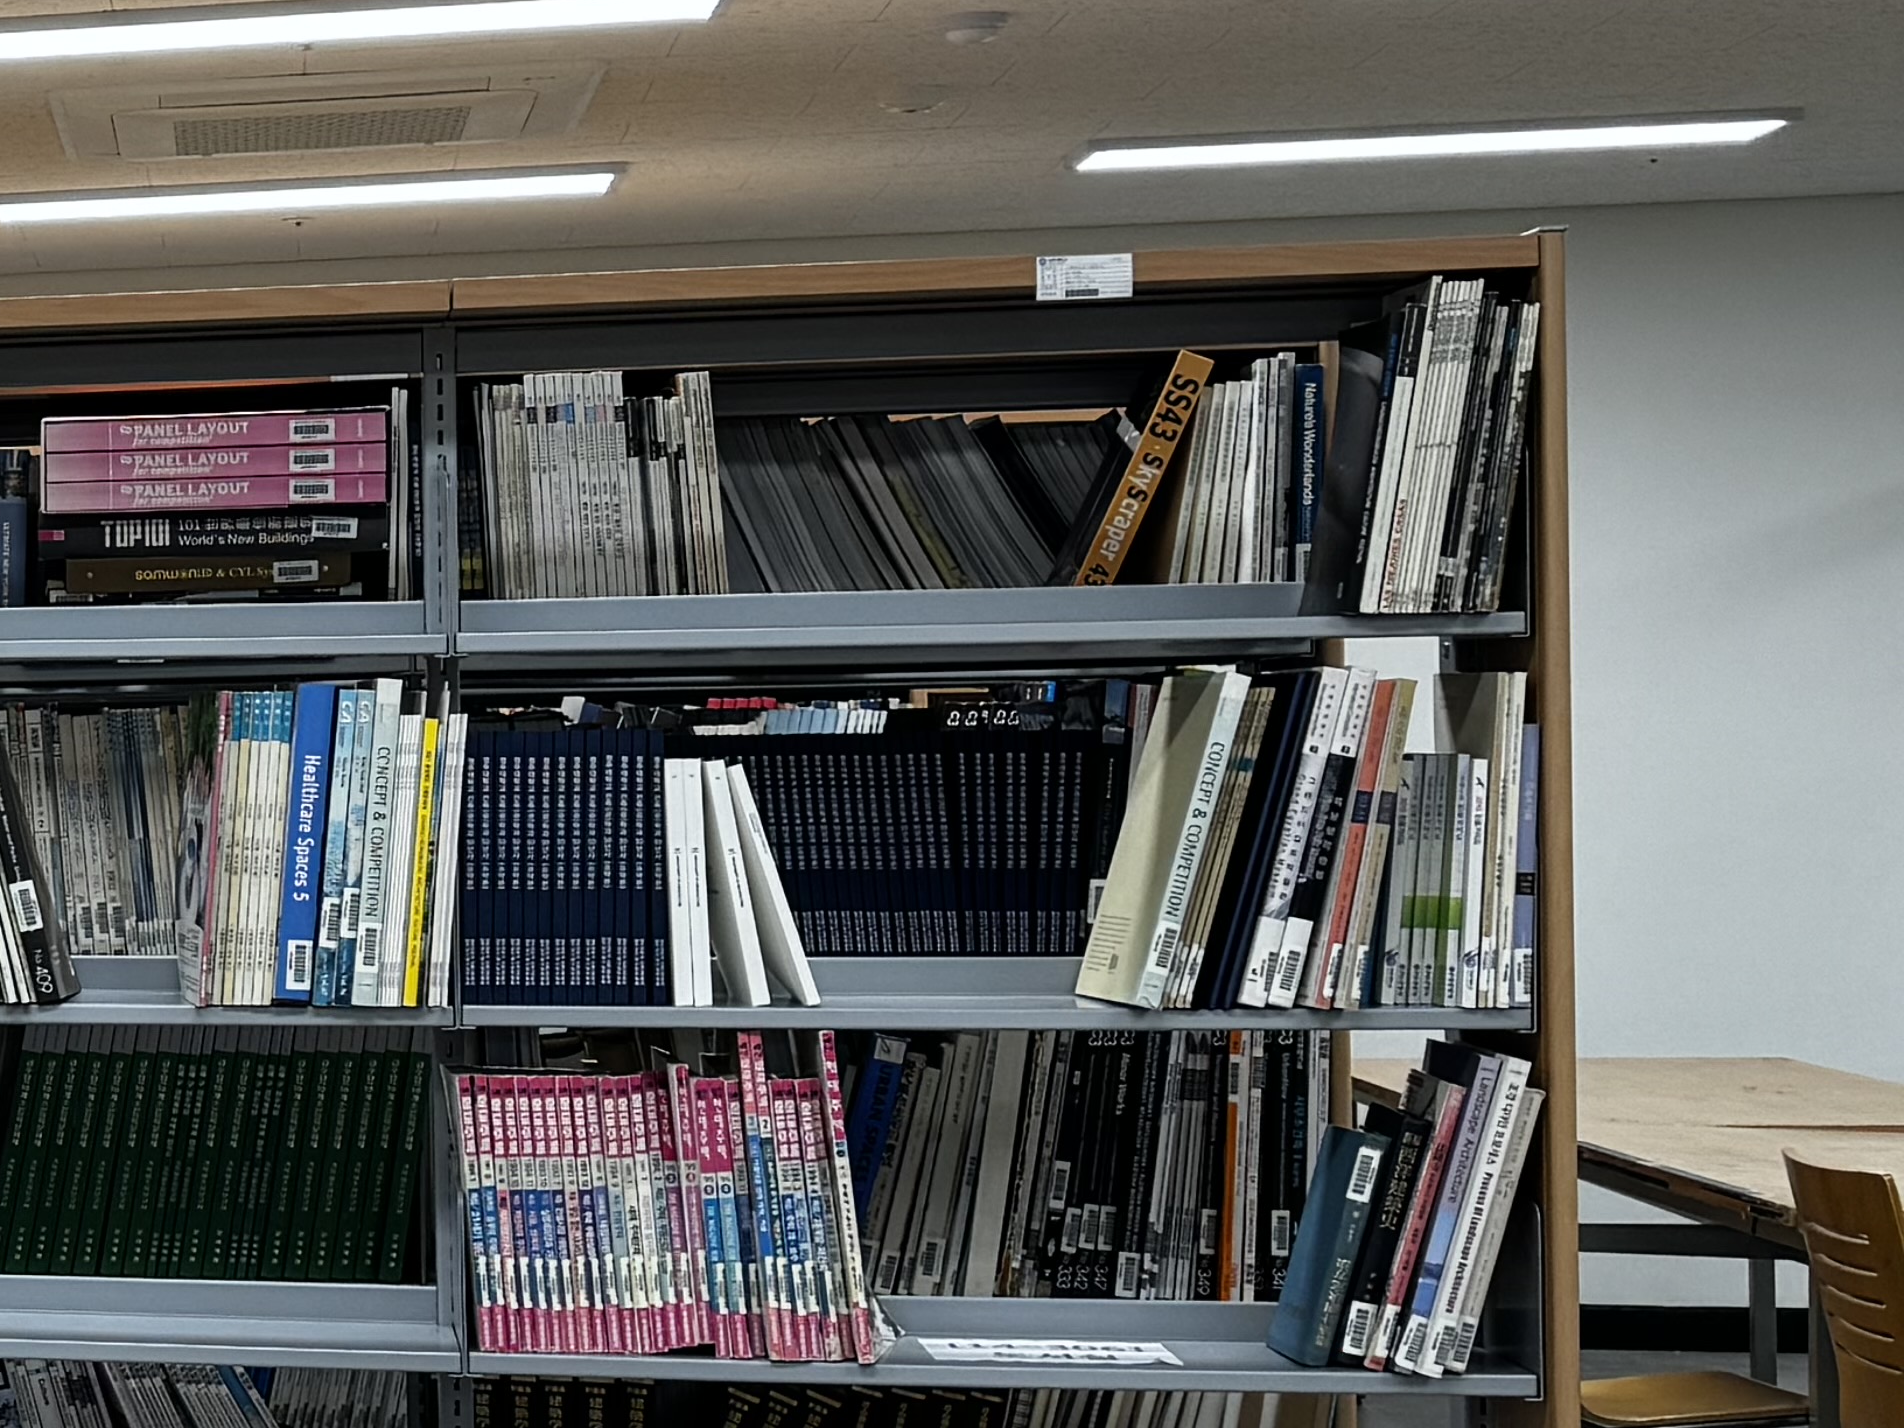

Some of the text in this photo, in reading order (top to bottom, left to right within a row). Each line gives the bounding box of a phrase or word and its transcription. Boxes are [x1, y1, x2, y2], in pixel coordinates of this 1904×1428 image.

[134, 421, 249, 439] PANEL LAYOUT
[1149, 373, 1200, 443] SS43
[134, 451, 250, 469] PANEL LAYOUT
[134, 481, 250, 499] PANEL LAYOUT
[228, 532, 256, 546] New
[370, 746, 391, 808] CONCEPT
[1199, 742, 1225, 805] CONCEPT
[293, 755, 322, 902] Healthcare Spaces 5
[364, 825, 385, 918] COMPETITION
[1162, 823, 1204, 919] COMPETITION
[1447, 1077, 1492, 1204] Landscape Architecture
